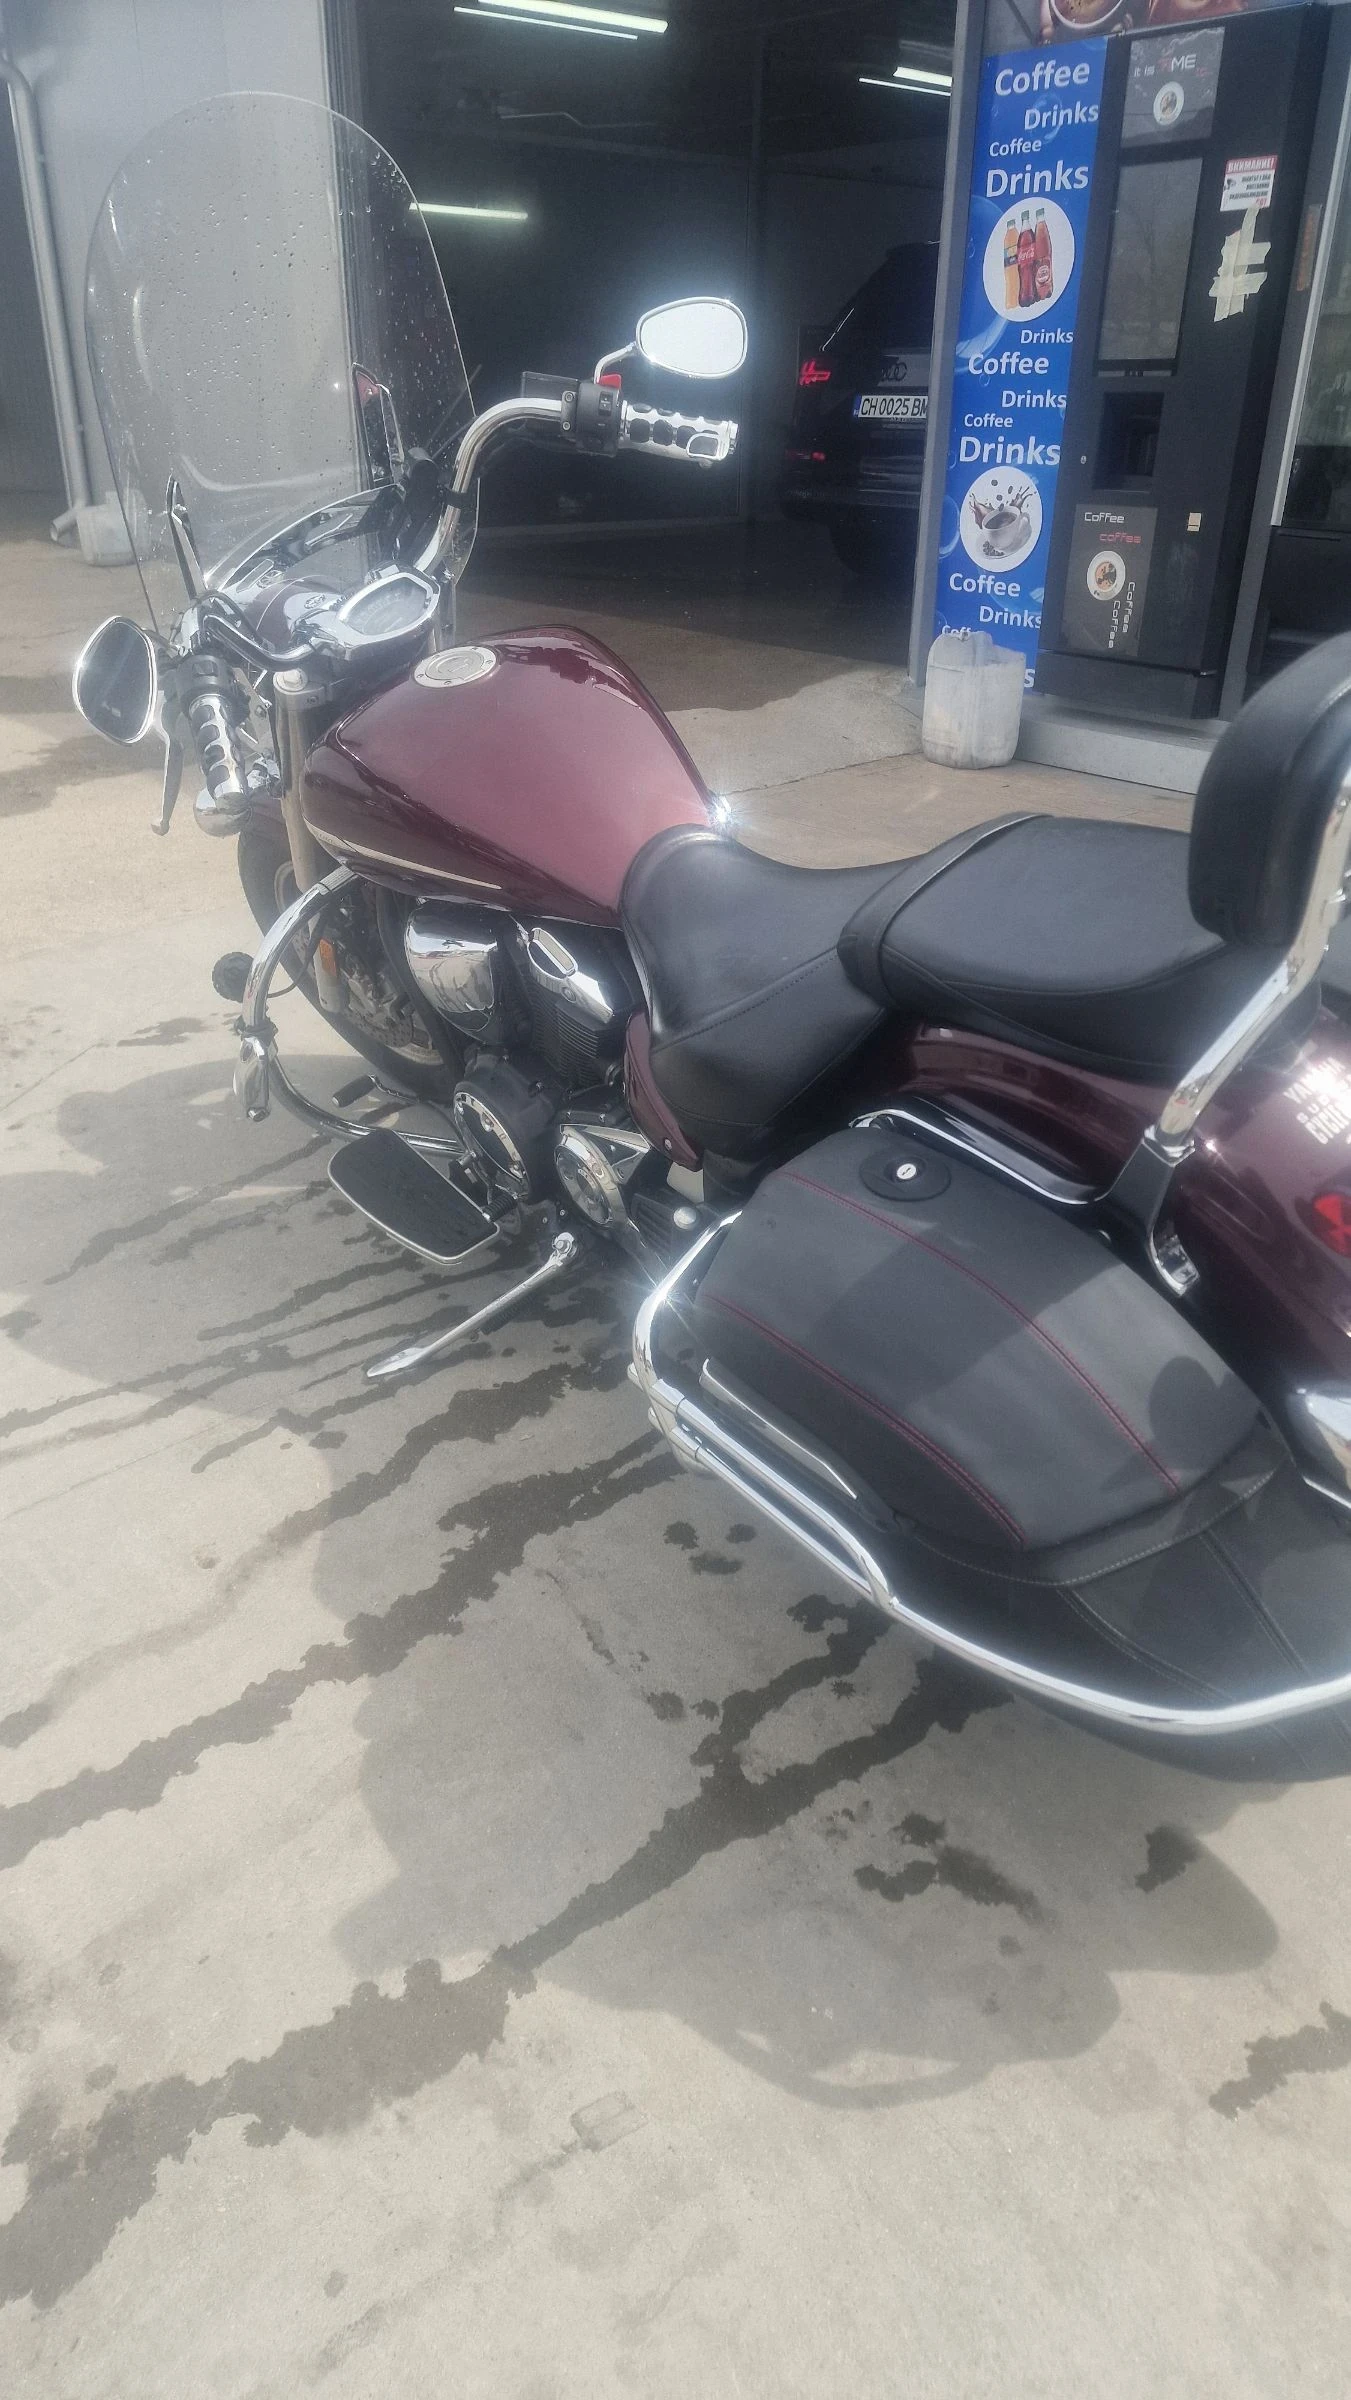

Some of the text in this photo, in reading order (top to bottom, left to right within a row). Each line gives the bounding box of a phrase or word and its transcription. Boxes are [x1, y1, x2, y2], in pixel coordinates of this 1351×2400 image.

[995, 60, 1090, 96] Coffee
[1024, 101, 1099, 130] Drinks
[989, 137, 1042, 157] Coffee
[986, 160, 1089, 198] Drinks
[1020, 328, 1074, 344] Drinks
[968, 352, 1050, 375] Coffee
[861, 398, 878, 415] CH
[879, 398, 910, 415] 0025
[1001, 389, 1067, 408] Drinks
[964, 413, 1014, 428] Coffee
[959, 436, 1061, 466] Drinks
[1084, 512, 1125, 523] Coffee
[949, 573, 1021, 597] Coffee
[979, 605, 1042, 629] Drinks
